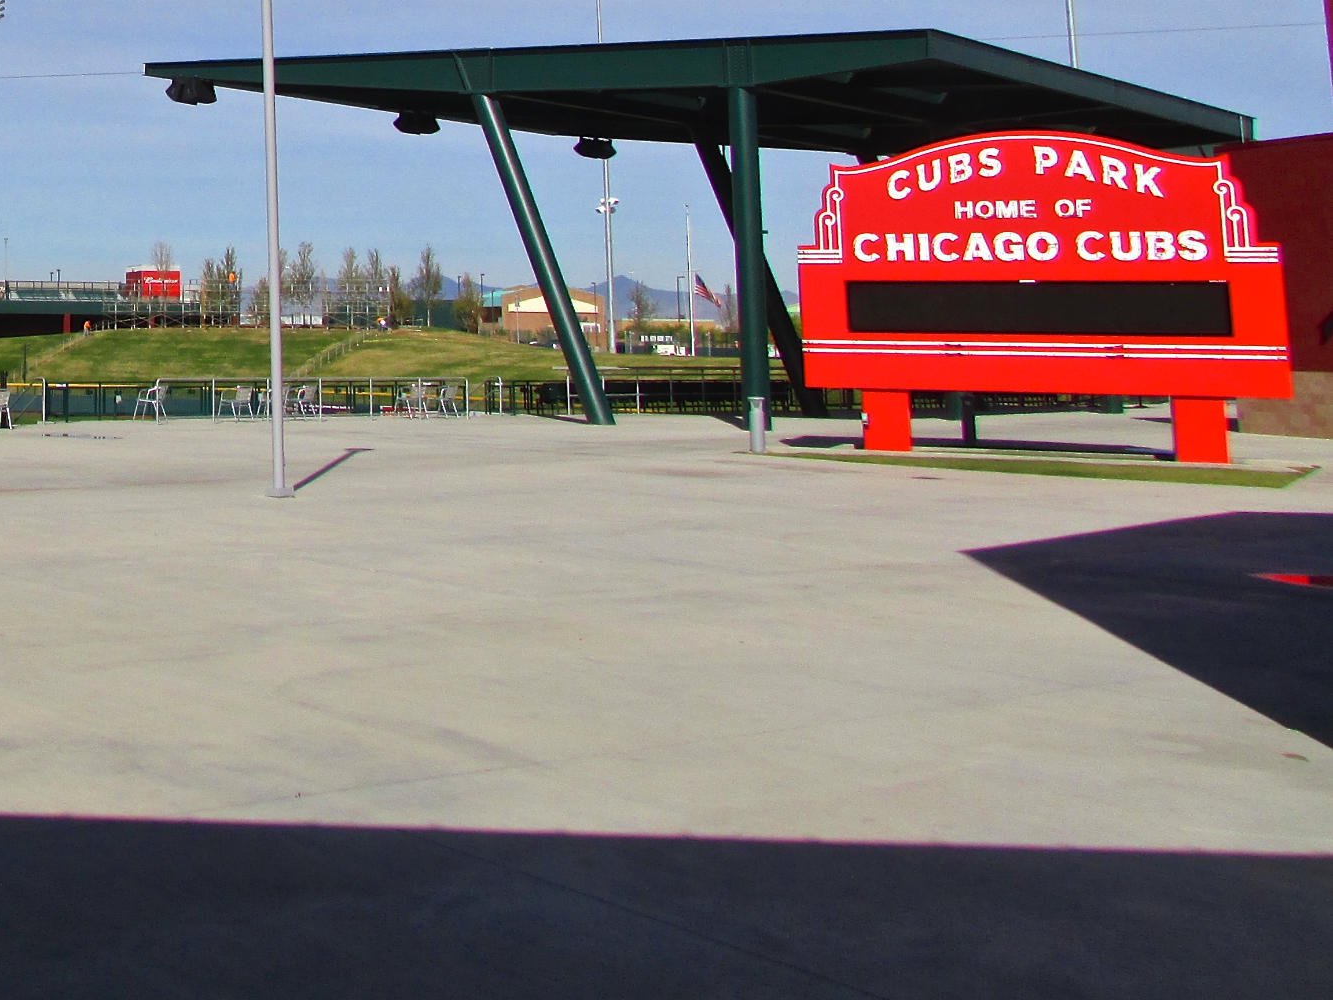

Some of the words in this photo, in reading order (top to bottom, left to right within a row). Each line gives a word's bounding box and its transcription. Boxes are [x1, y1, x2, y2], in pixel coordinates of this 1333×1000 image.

[886, 147, 1003, 200] CUBS
[1032, 145, 1165, 198] PARK
[954, 199, 1037, 220] HOME
[1054, 198, 1093, 218] OF
[853, 230, 1060, 262] CHICAGO
[1075, 229, 1209, 262] CUBS
